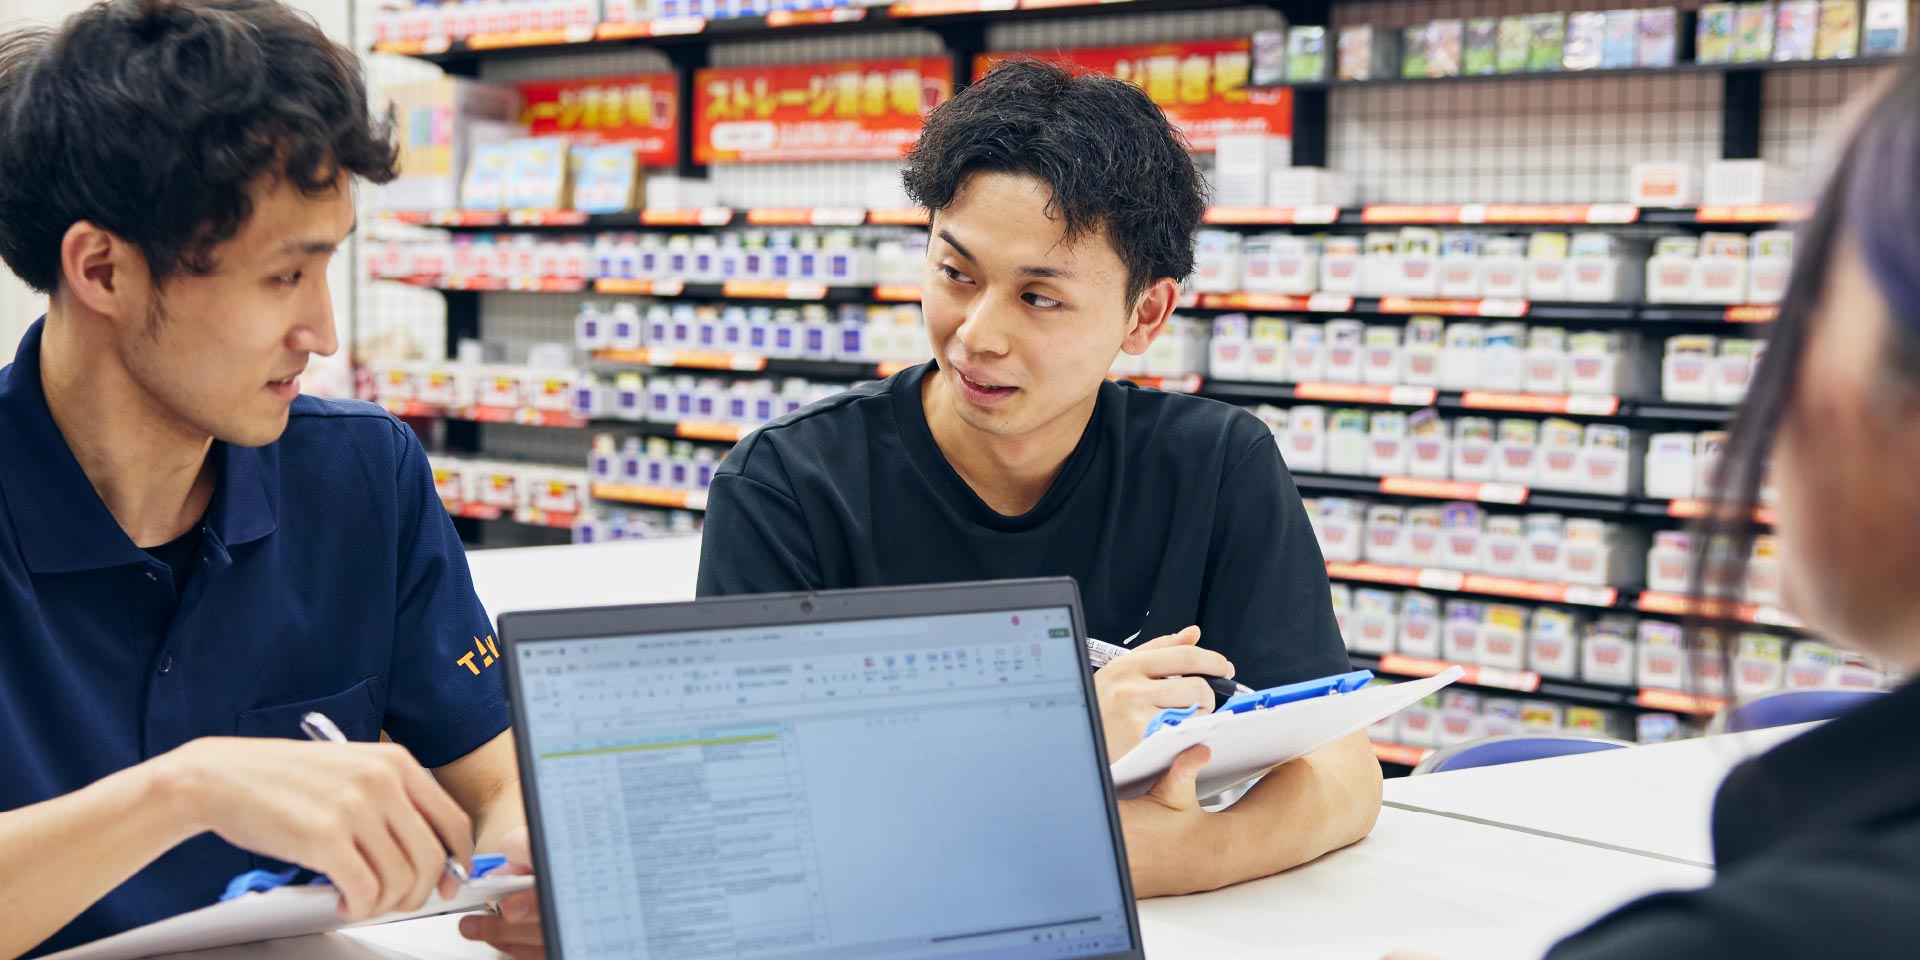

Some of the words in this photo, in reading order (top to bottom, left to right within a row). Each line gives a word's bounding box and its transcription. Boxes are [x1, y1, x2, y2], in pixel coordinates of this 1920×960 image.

[706, 69, 920, 119] ストレージ置き場
